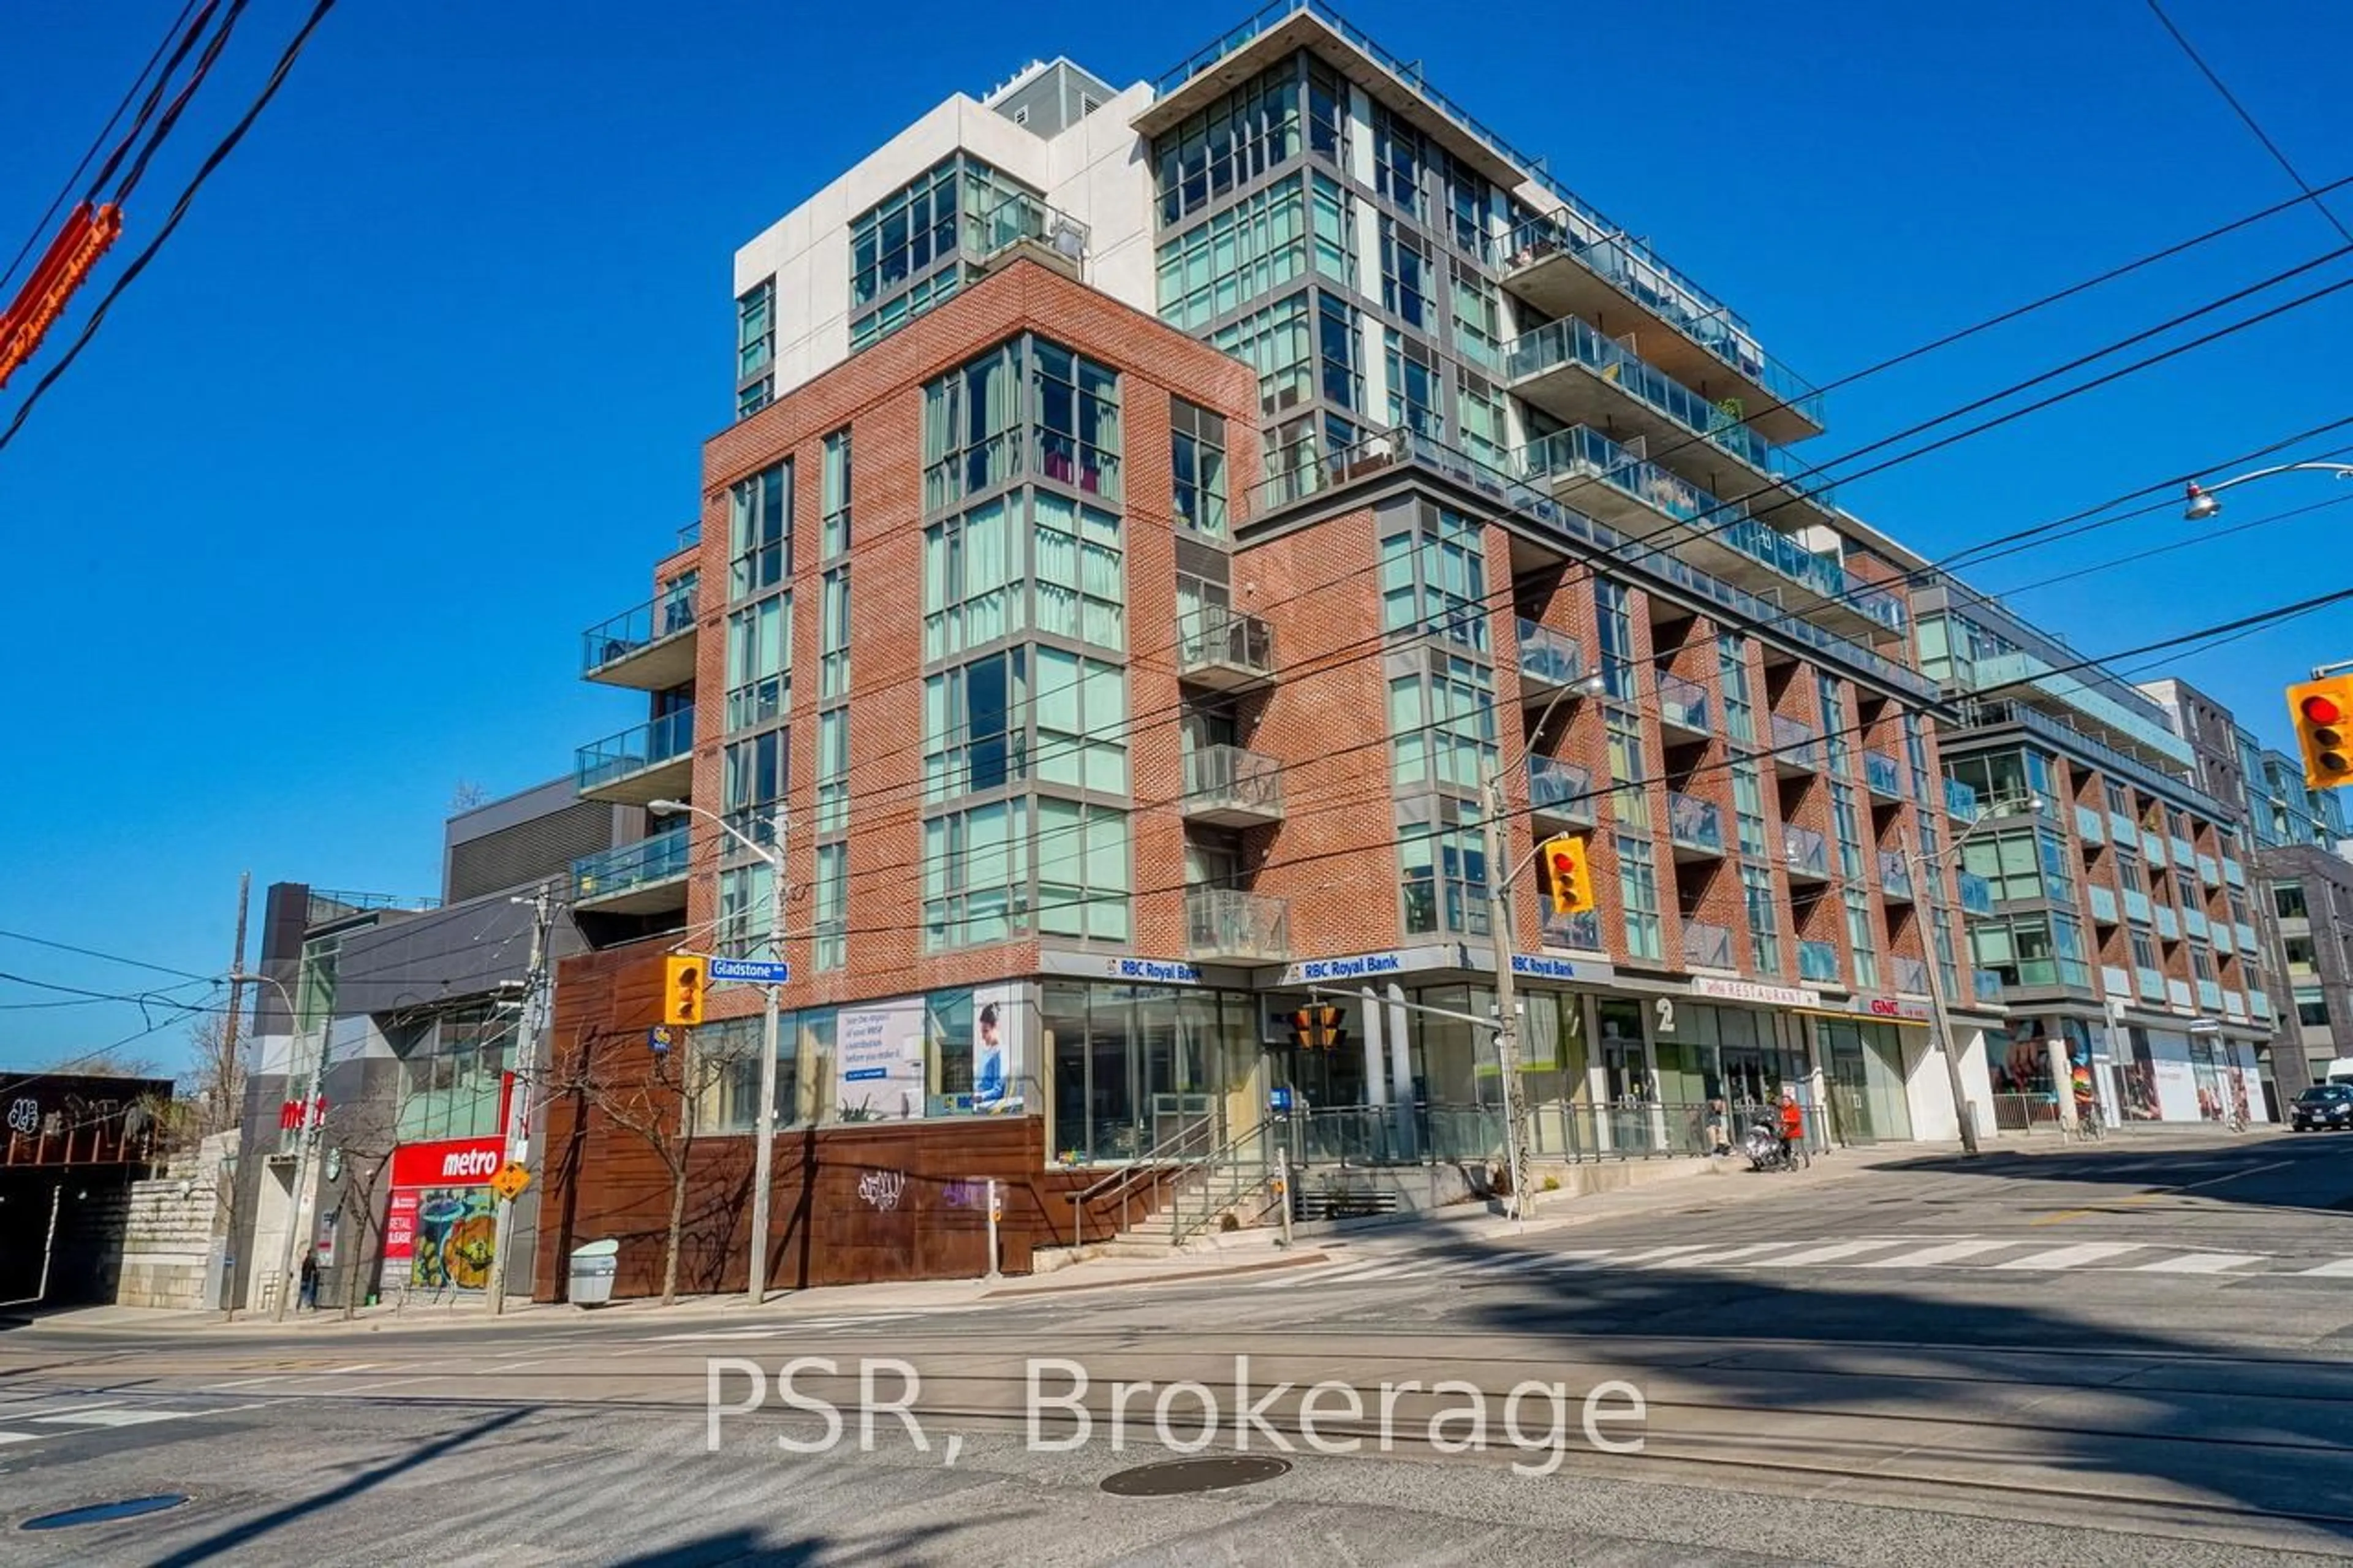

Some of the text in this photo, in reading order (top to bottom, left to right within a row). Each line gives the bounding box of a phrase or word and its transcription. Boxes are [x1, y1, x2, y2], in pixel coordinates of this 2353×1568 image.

[714, 960, 771, 977] Gladstone
[1121, 960, 1203, 981] RBC Royal Bank
[1305, 953, 1399, 979] RBC Royal Bank
[1529, 958, 1553, 976] Royal
[1553, 960, 1574, 977] Bank
[1727, 983, 1801, 1004] RESTAURANT
[1656, 998, 1675, 1031] 2
[1871, 999, 1900, 1015] GNC
[442, 1147, 498, 1177] metro
